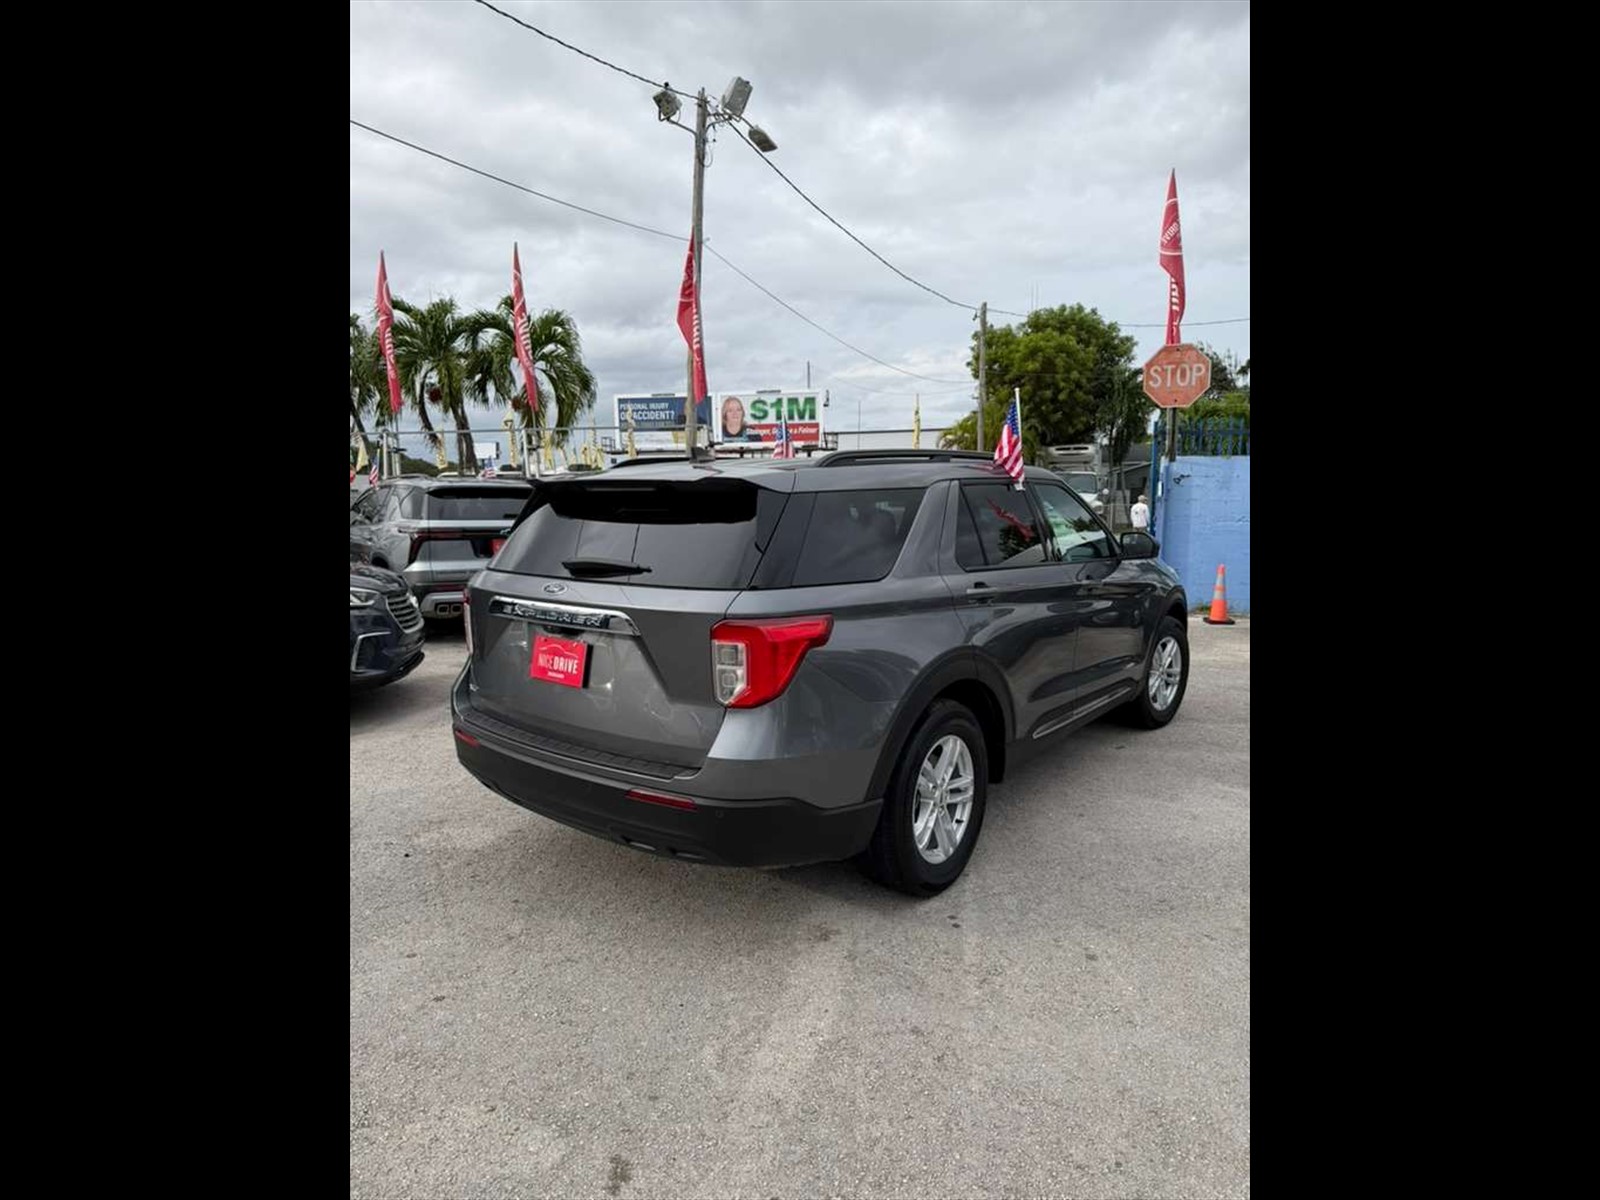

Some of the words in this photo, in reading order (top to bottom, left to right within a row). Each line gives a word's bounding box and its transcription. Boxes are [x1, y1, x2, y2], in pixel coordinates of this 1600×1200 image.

[1149, 363, 1206, 388] STOP
[633, 410, 675, 421] ACCIDENT?
[649, 402, 669, 410] INJURY
[750, 396, 816, 422] $1M
[503, 604, 602, 627] EXPLORER
